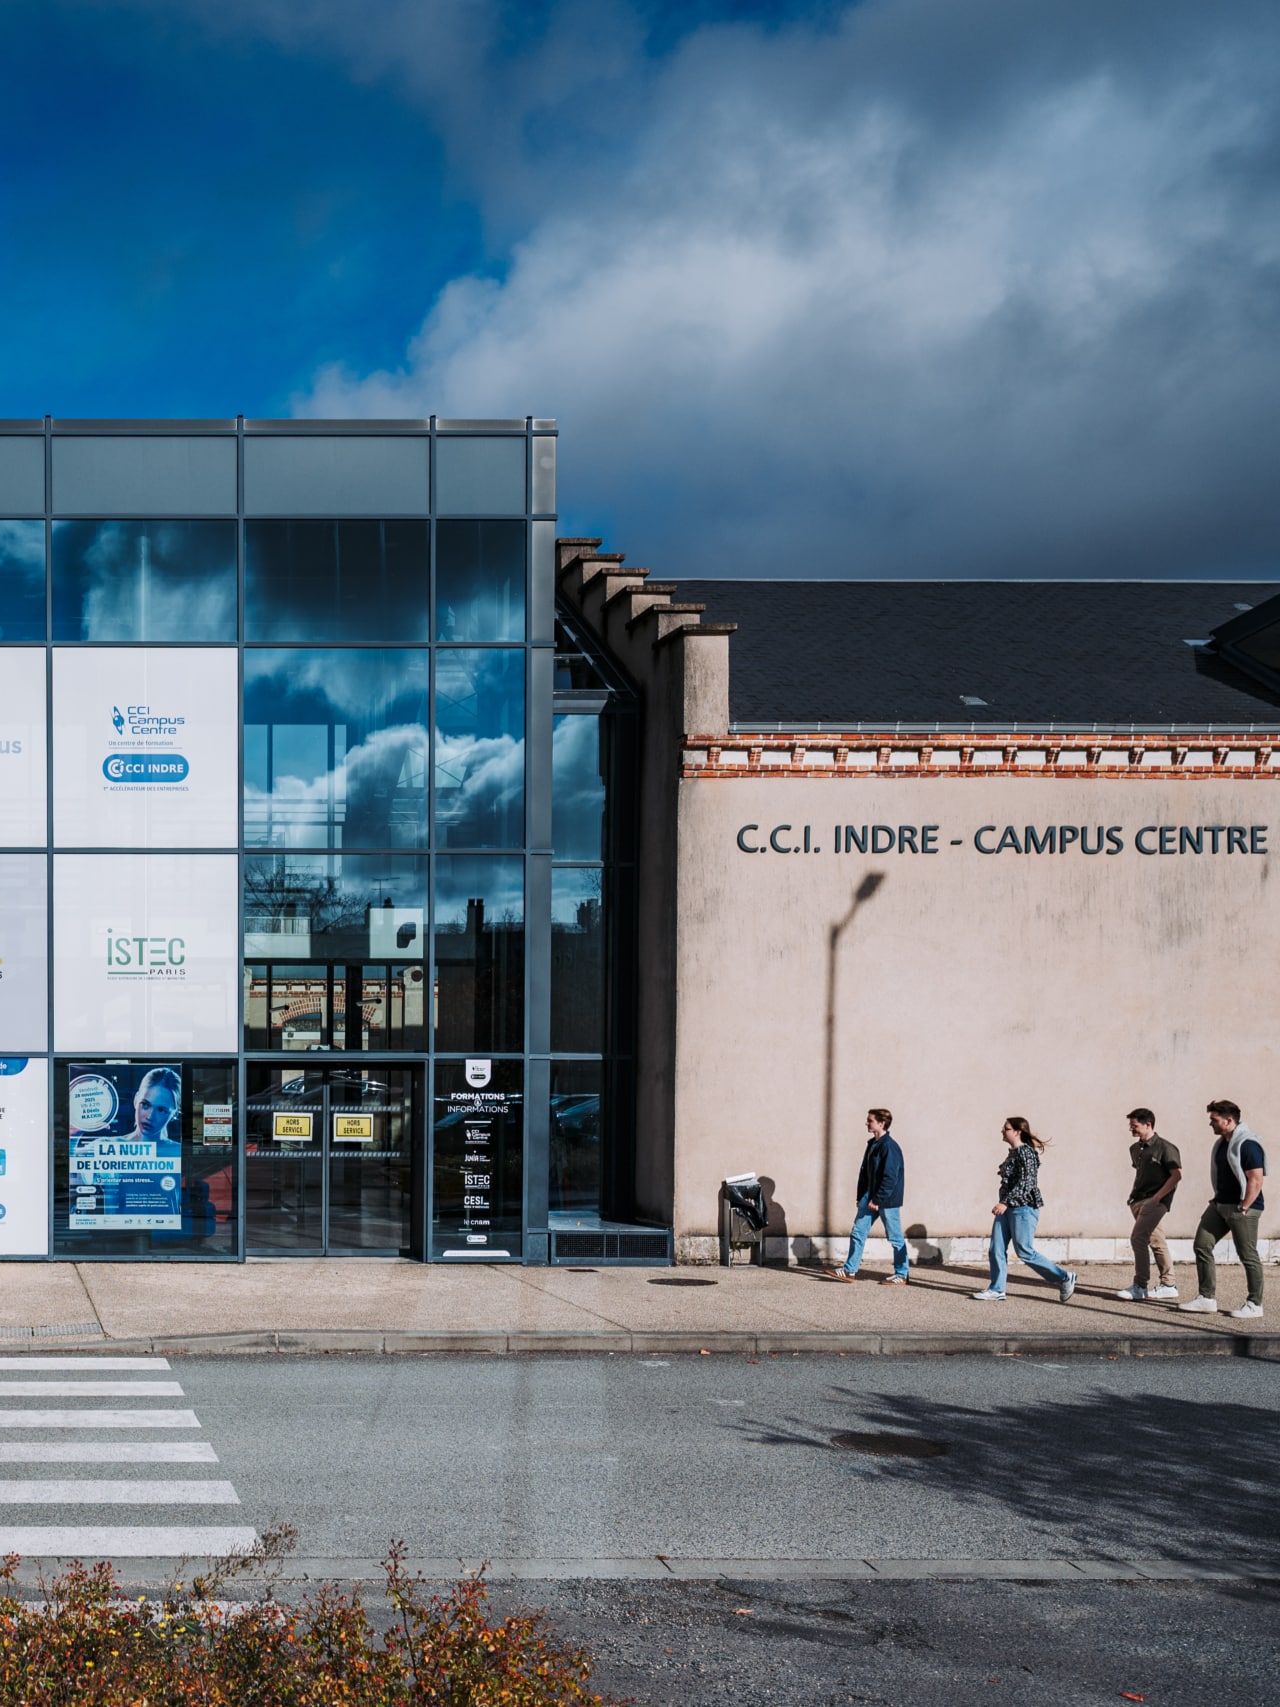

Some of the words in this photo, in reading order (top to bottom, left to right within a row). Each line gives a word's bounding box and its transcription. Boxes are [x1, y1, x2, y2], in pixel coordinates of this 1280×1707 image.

[128, 706, 150, 715] CCI
[128, 716, 185, 726] Campus
[132, 725, 177, 734] Centre
[125, 764, 145, 773] CCI
[148, 764, 184, 773] INDRE
[736, 824, 821, 854] C.C.I.
[834, 825, 940, 854] INDRE
[974, 825, 1124, 855] CAMPUS
[1135, 825, 1268, 855] CENTRE
[99, 1144, 116, 1156] LA
[119, 1144, 152, 1156] NUIT
[77, 1160, 91, 1170] DE
[93, 1160, 174, 1170] L'ORIENTATION
